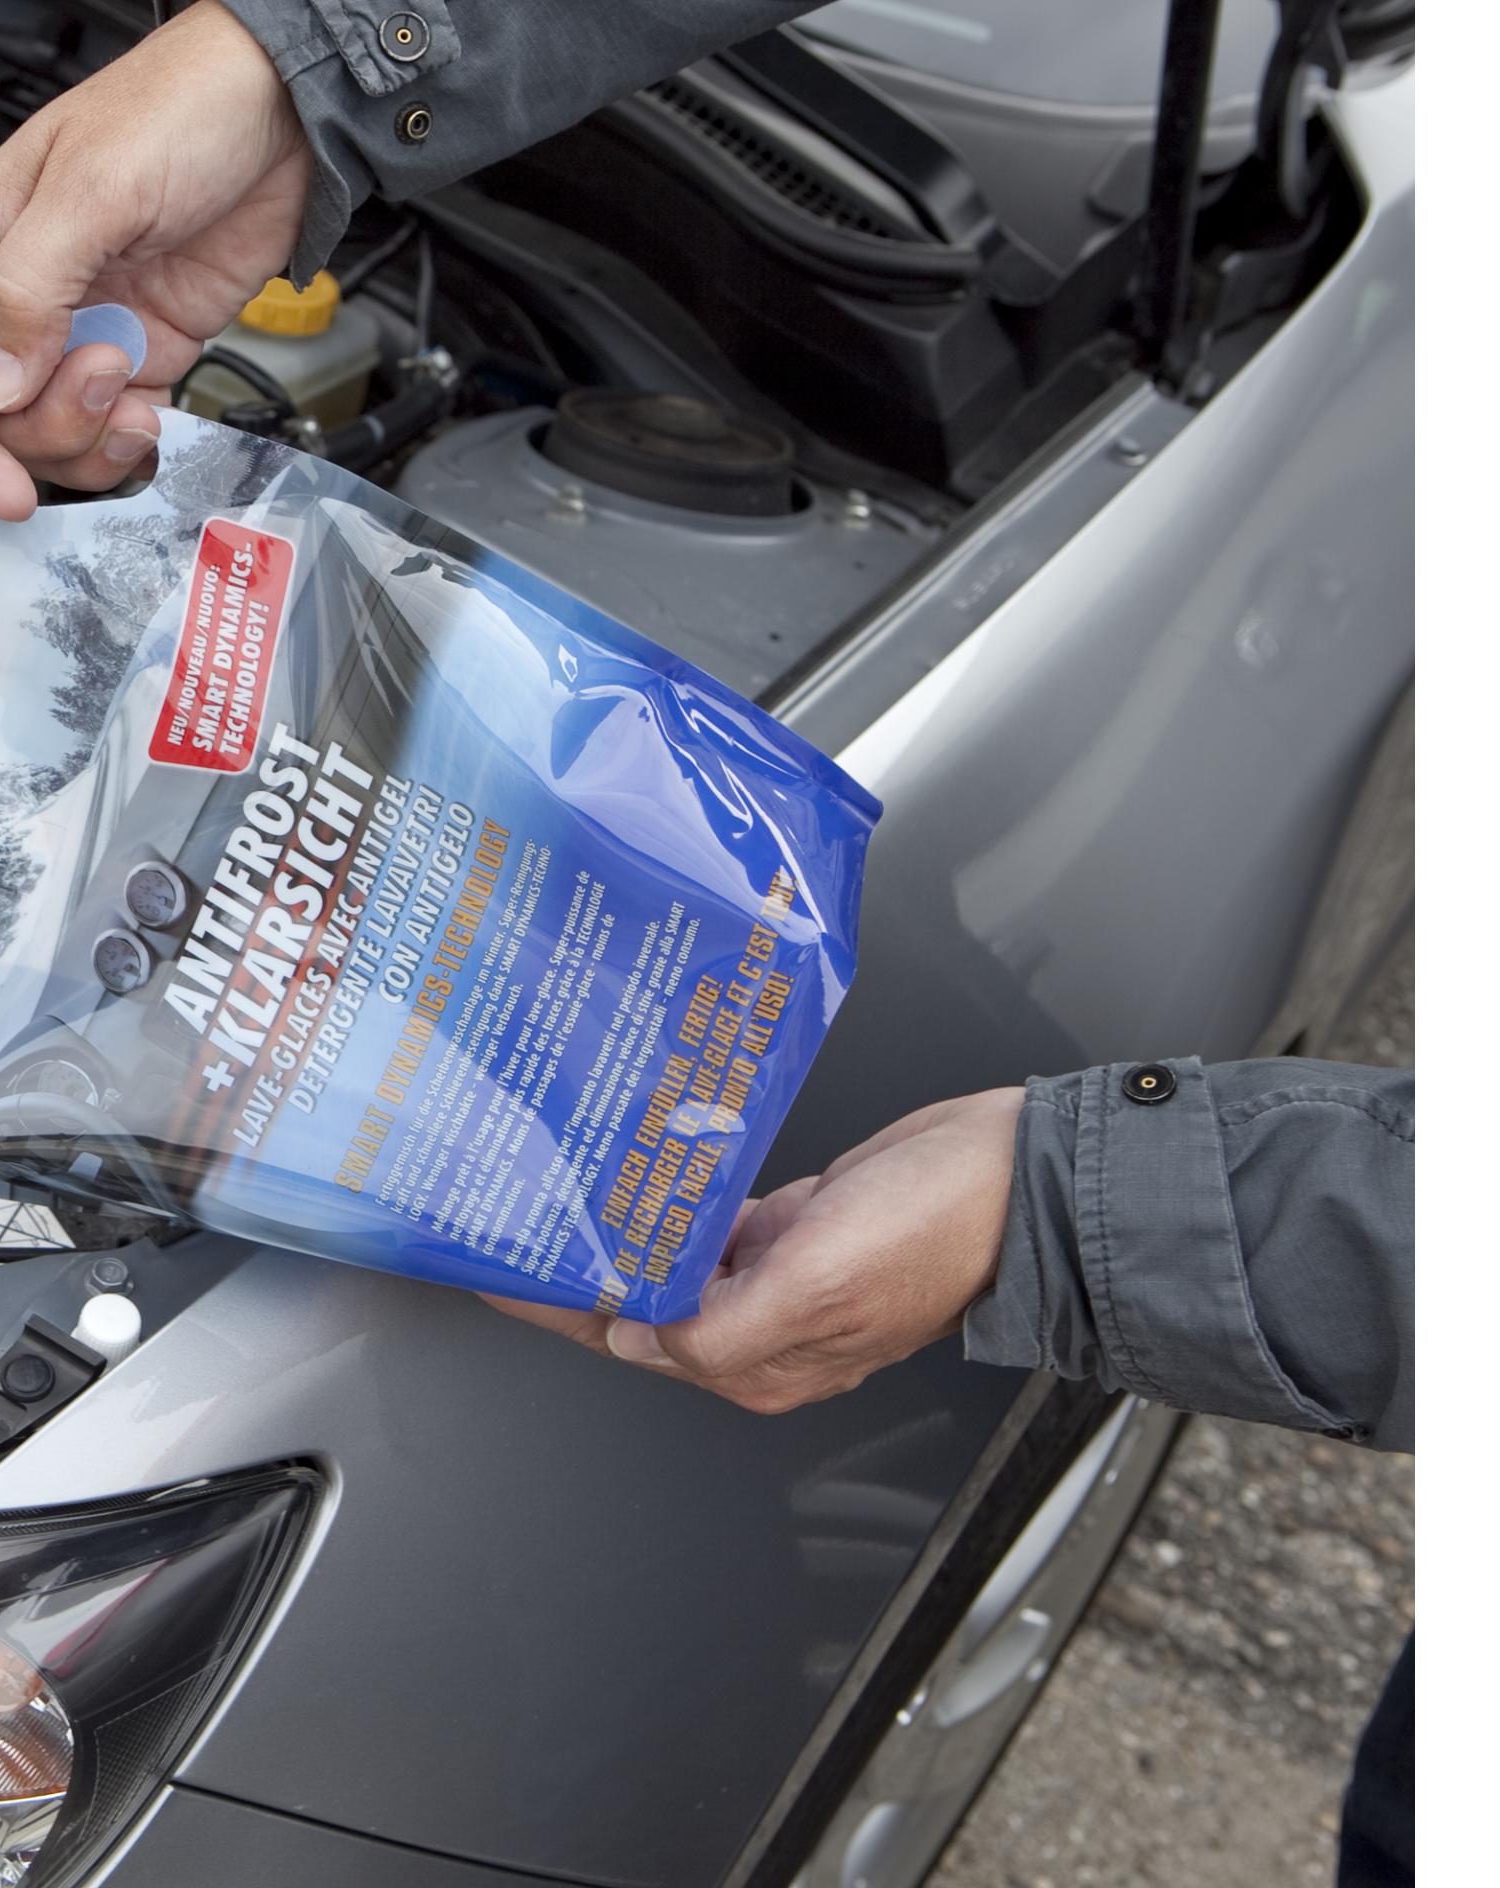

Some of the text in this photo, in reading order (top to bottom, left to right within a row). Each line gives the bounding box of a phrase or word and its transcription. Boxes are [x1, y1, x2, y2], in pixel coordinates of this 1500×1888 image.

[167, 564, 222, 745] NEU/NOUVEAU/NUOVO:
[193, 541, 257, 752] SMART DYNAMICS-
[219, 600, 270, 755] TECHNOLOGY!
[164, 721, 322, 1034] ANTIFROST
[375, 800, 478, 1006] CON ANTIGELO
[498, 838, 536, 928] Super-Reinigungs-
[575, 867, 592, 886] de
[548, 885, 585, 965] Super-puissance
[575, 881, 605, 944] TECHNOLOGIE
[232, 772, 413, 1148] LAVE-GLACES AVEC ANTIGEL
[287, 784, 444, 1114] DETERGENTE LAVAVETRI
[482, 931, 506, 965] Winter.
[569, 942, 586, 959] la
[632, 920, 660, 969] invernale.
[739, 923, 780, 980] C'EST
[474, 965, 492, 984] im
[523, 969, 557, 1024] lave-glace.
[554, 965, 580, 1001] grâce
[615, 967, 646, 1014] periodo
[726, 979, 753, 1005] ET
[334, 816, 513, 1194] SMART DYNAMICS-TECHNOLOGY
[390, 844, 551, 1213] kraft und schnellere Schlierenbeseitigung dank SMART DYNAMICS-TECHNO-
[541, 999, 563, 1030] traces
[607, 1009, 626, 1032] nel
[426, 984, 483, 1096] Scheibenwaschanlage
[515, 1023, 537, 1054] pour
[531, 1029, 551, 1053] des
[587, 1031, 617, 1078] lavavetri
[683, 1006, 744, 1111] LAVE-GLACE
[464, 1212, 487, 1248] SMART
[480, 1158, 515, 1211] DYNAMICS.
[507, 1123, 529, 1155] Moins
[520, 1104, 538, 1123] de
[530, 1058, 557, 1107] passages
[549, 1039, 566, 1058] de
[589, 925, 612, 962] moins
[601, 910, 617, 930] de
[516, 1049, 545, 1090] rapide
[521, 901, 684, 1274] Super potenza detergente ed eliminazione veloce di strie grazie alla SMART
[406, 1189, 431, 1223] LOGY.
[420, 1145, 454, 1195] Weniger
[441, 1091, 476, 1146] Wischtakte
[471, 1035, 505, 1085] weniger
[491, 984, 523, 1035] Verbrauch.
[415, 1094, 434, 1117] die
[486, 1085, 510, 1115] pour
[505, 1085, 530, 1114] plus
[537, 1163, 601, 1282] DYNAMICS-TECHNOLOGY.
[592, 1131, 613, 1161] Meno
[604, 1085, 637, 1132] passate
[624, 1068, 641, 1087] dei
[633, 1004, 667, 1067] tergicristalli
[664, 966, 682, 996] meno
[676, 918, 700, 963] consumo.
[599, 974, 724, 1228] EINFACH EINFÜLLEN, FERTIG!
[644, 969, 795, 1284] IMPIEGO FACILE, PRONTO ALL'USO!
[672, 1111, 700, 1135] LE
[375, 1134, 416, 1205] Fertiggemisch
[478, 1112, 514, 1172] élimination
[557, 1133, 577, 1157] per
[451, 1159, 475, 1189] prêt
[470, 1170, 488, 1187] et
[624, 1135, 689, 1247] RECHARGER
[431, 1187, 460, 1232] Mélange
[446, 1183, 484, 1243] nettoyage
[482, 1179, 525, 1255] consommation.
[521, 1188, 552, 1230] pronta
[504, 1228, 530, 1266] Miscela
[612, 1246, 642, 1276] DE
